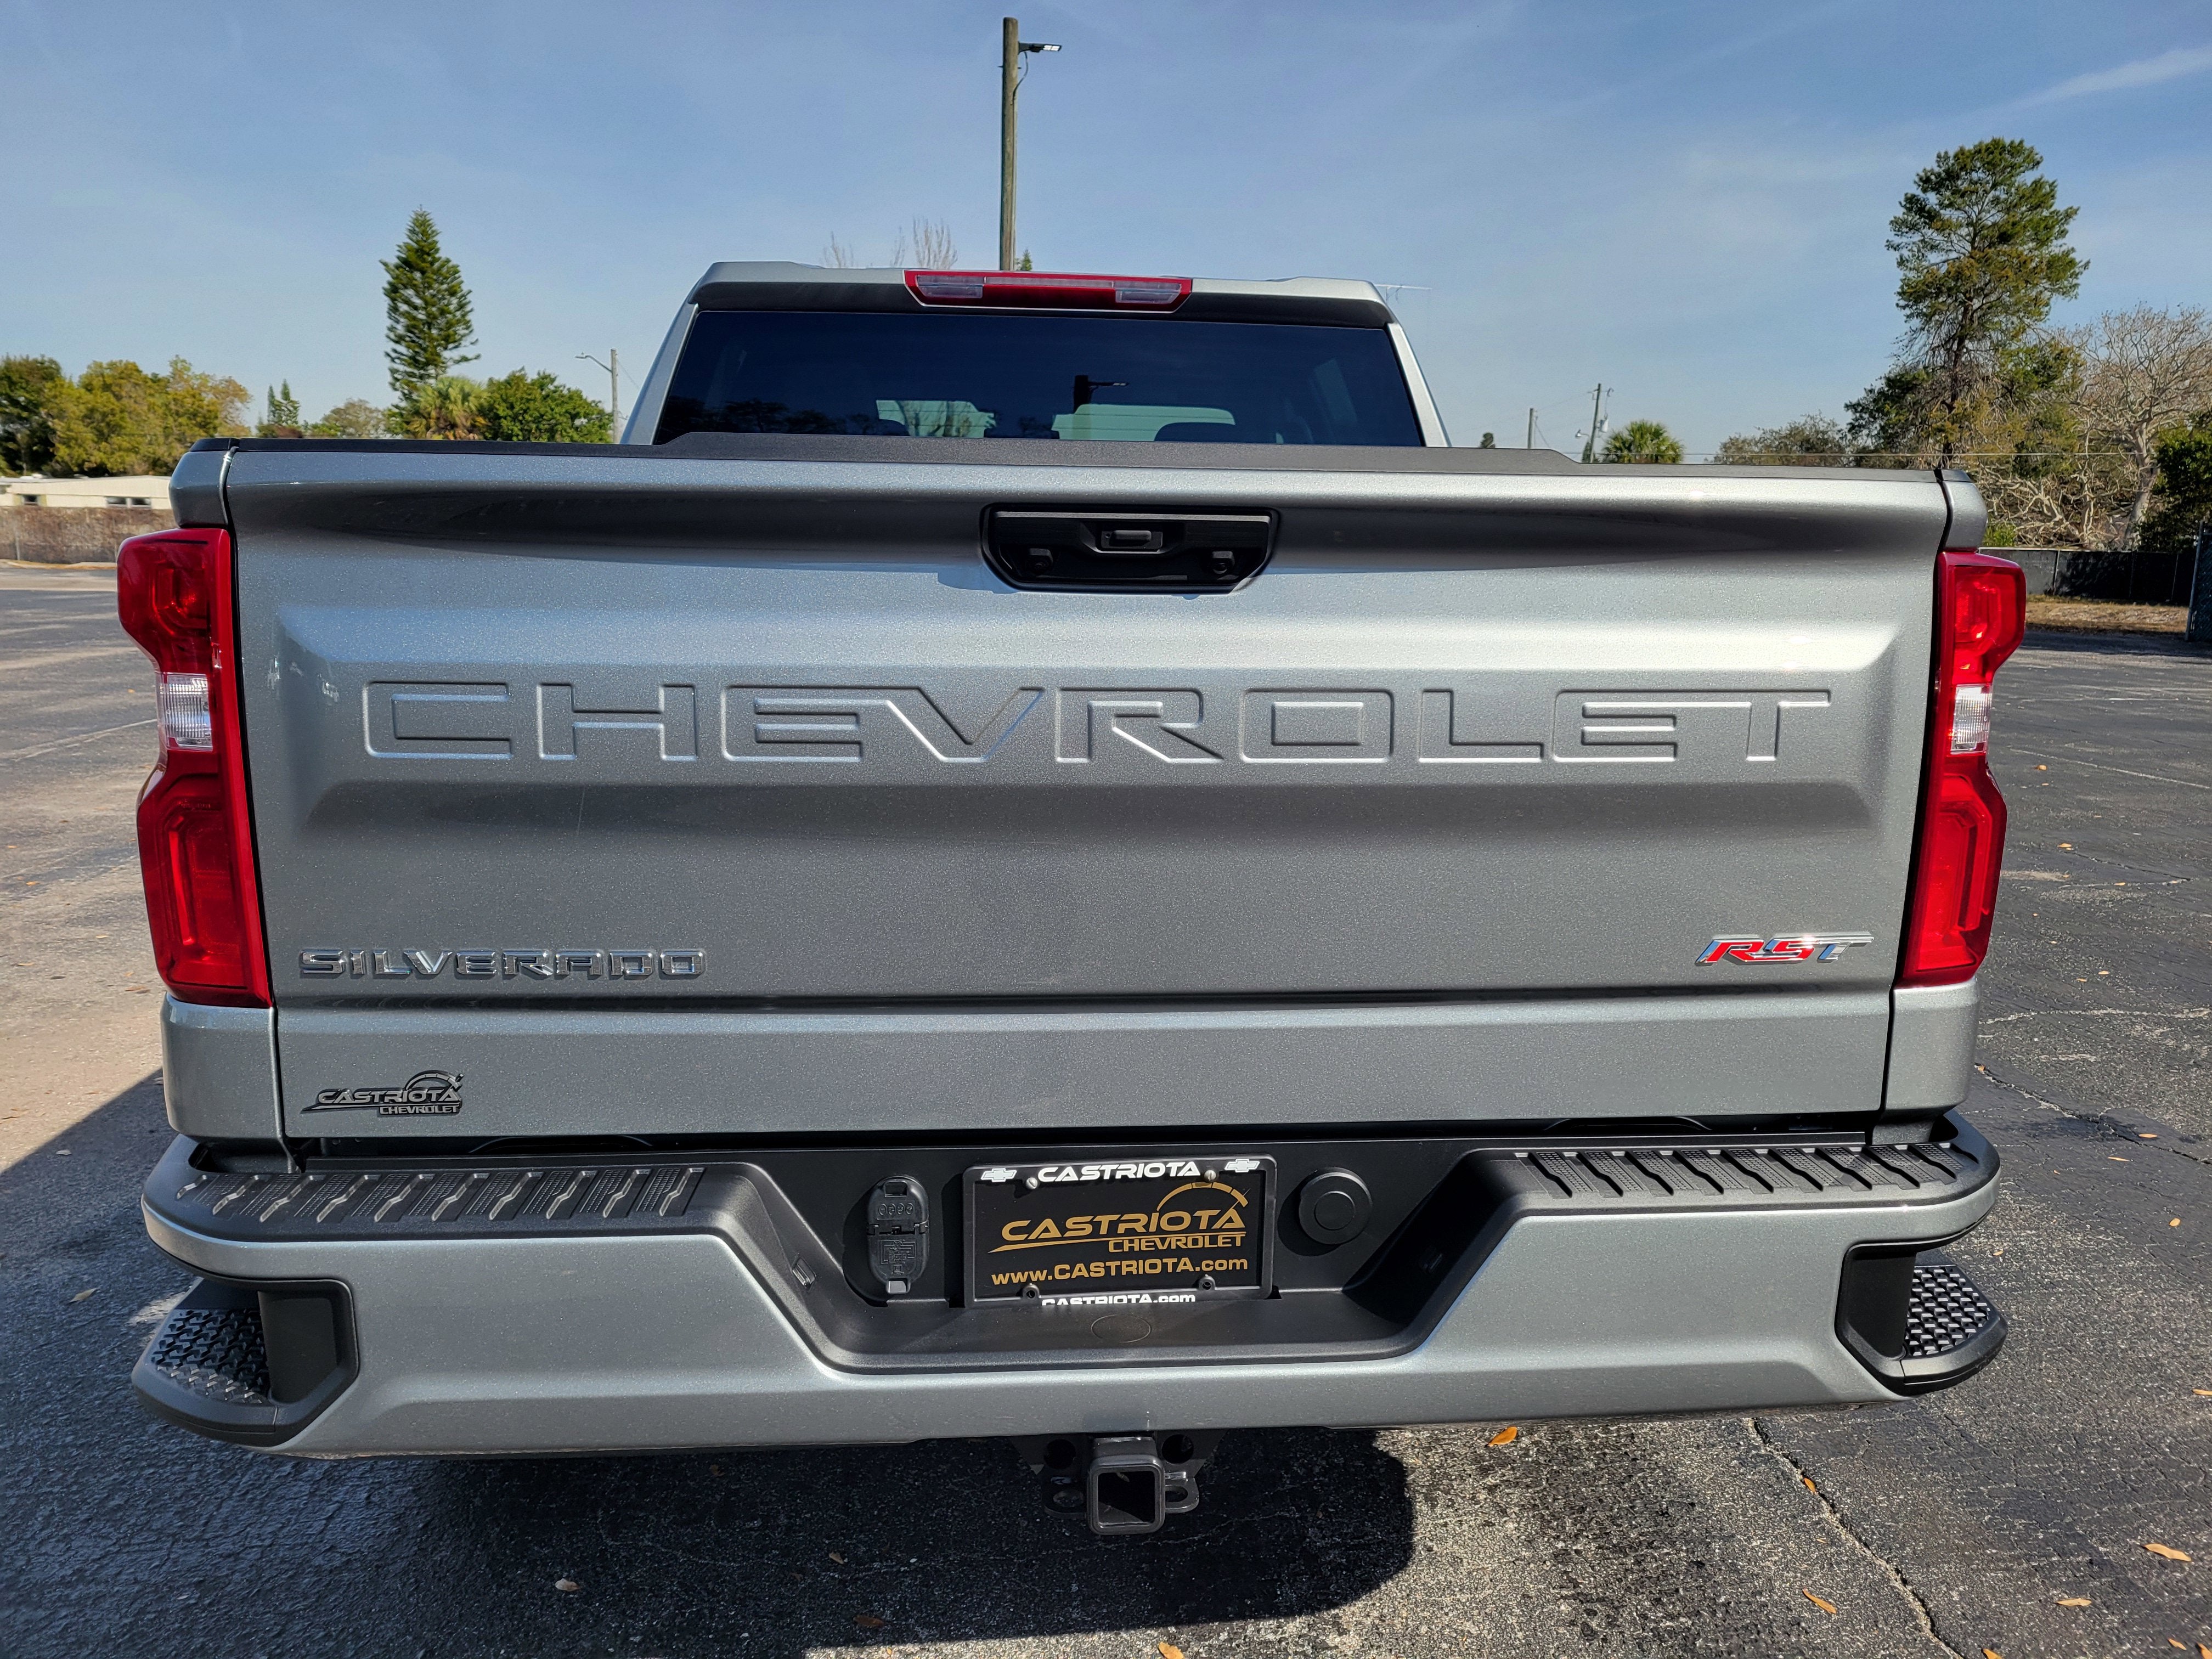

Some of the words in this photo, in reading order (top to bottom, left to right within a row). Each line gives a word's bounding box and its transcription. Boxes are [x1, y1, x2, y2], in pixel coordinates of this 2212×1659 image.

[363, 681, 1831, 763] CHEVROLET
[300, 949, 706, 976] SILVERADO
[1695, 935, 1875, 964] RST
[318, 1088, 461, 1104] CASTRIOTA
[379, 1104, 459, 1115] CHEVROLET
[1037, 1161, 1201, 1182] CASTRIOTA
[1001, 1209, 1245, 1240] CASTRIOTA
[1108, 1234, 1246, 1252] CHEVROLET
[991, 1257, 1248, 1285] www.CASTRIOTA.com
